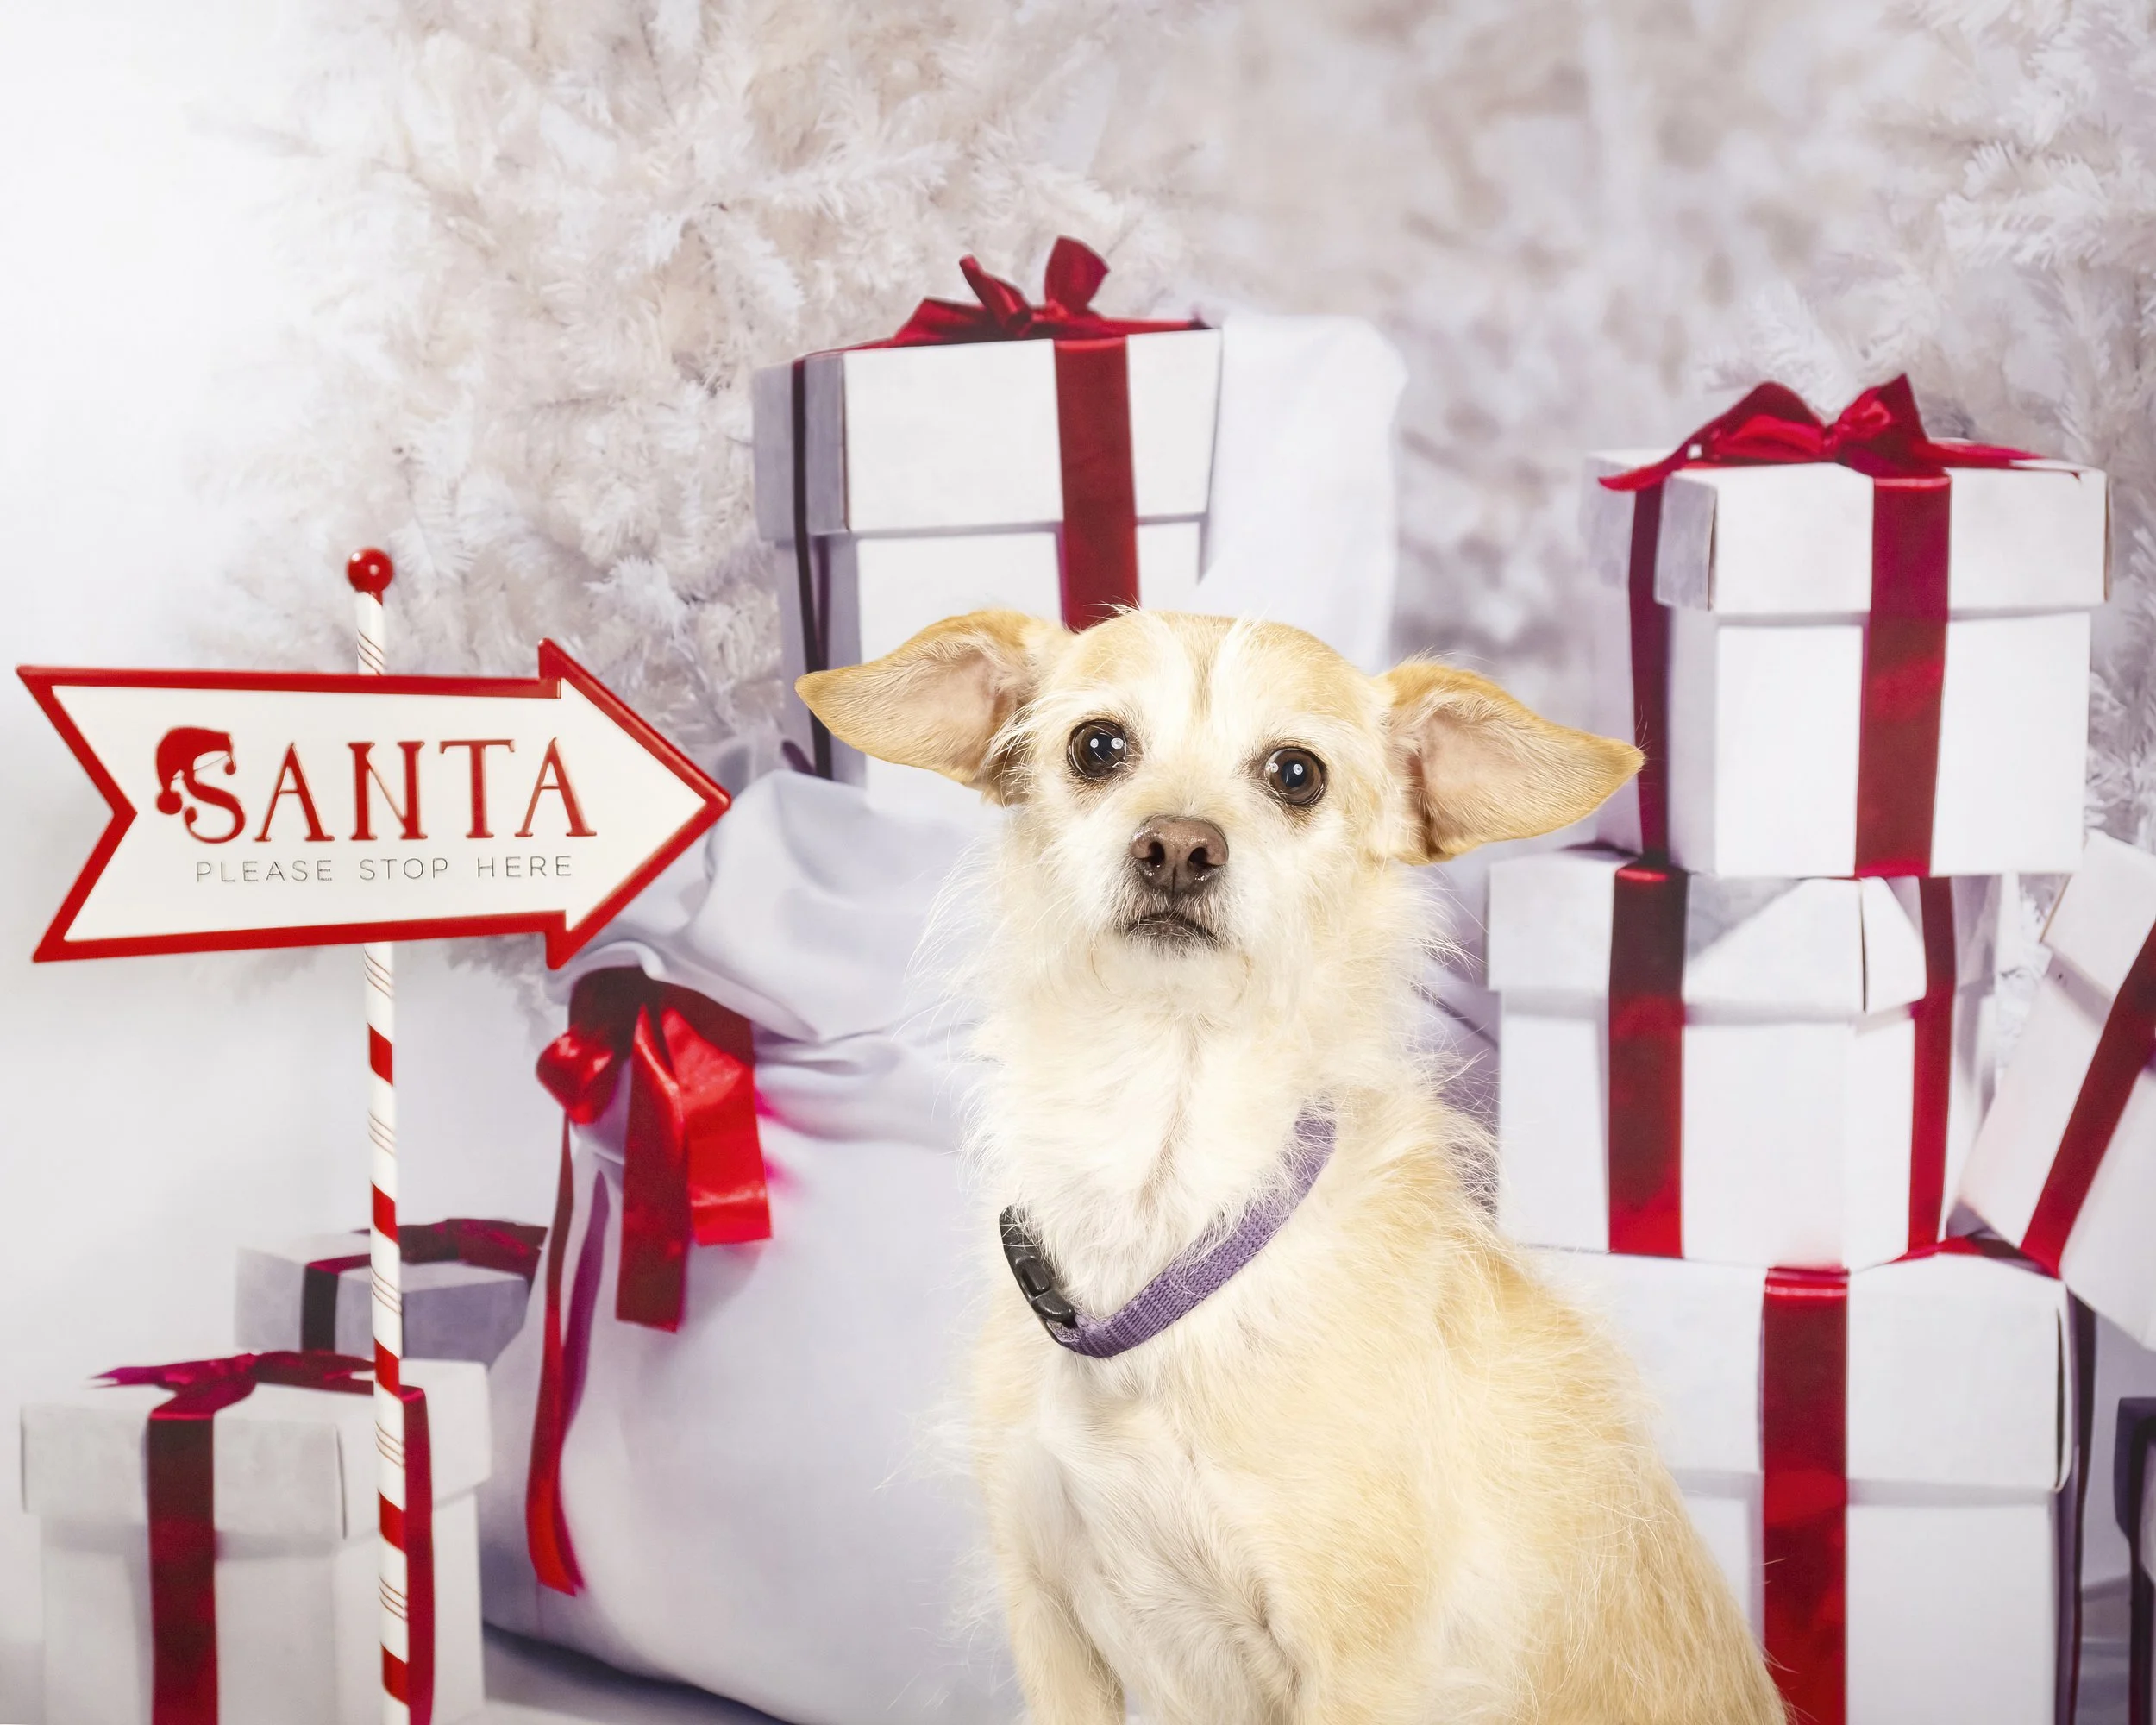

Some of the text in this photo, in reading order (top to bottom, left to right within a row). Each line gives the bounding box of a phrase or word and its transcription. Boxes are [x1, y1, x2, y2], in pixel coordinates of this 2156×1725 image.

[183, 737, 597, 844] SANTA
[196, 855, 573, 883] PLEASE STOP HERE
